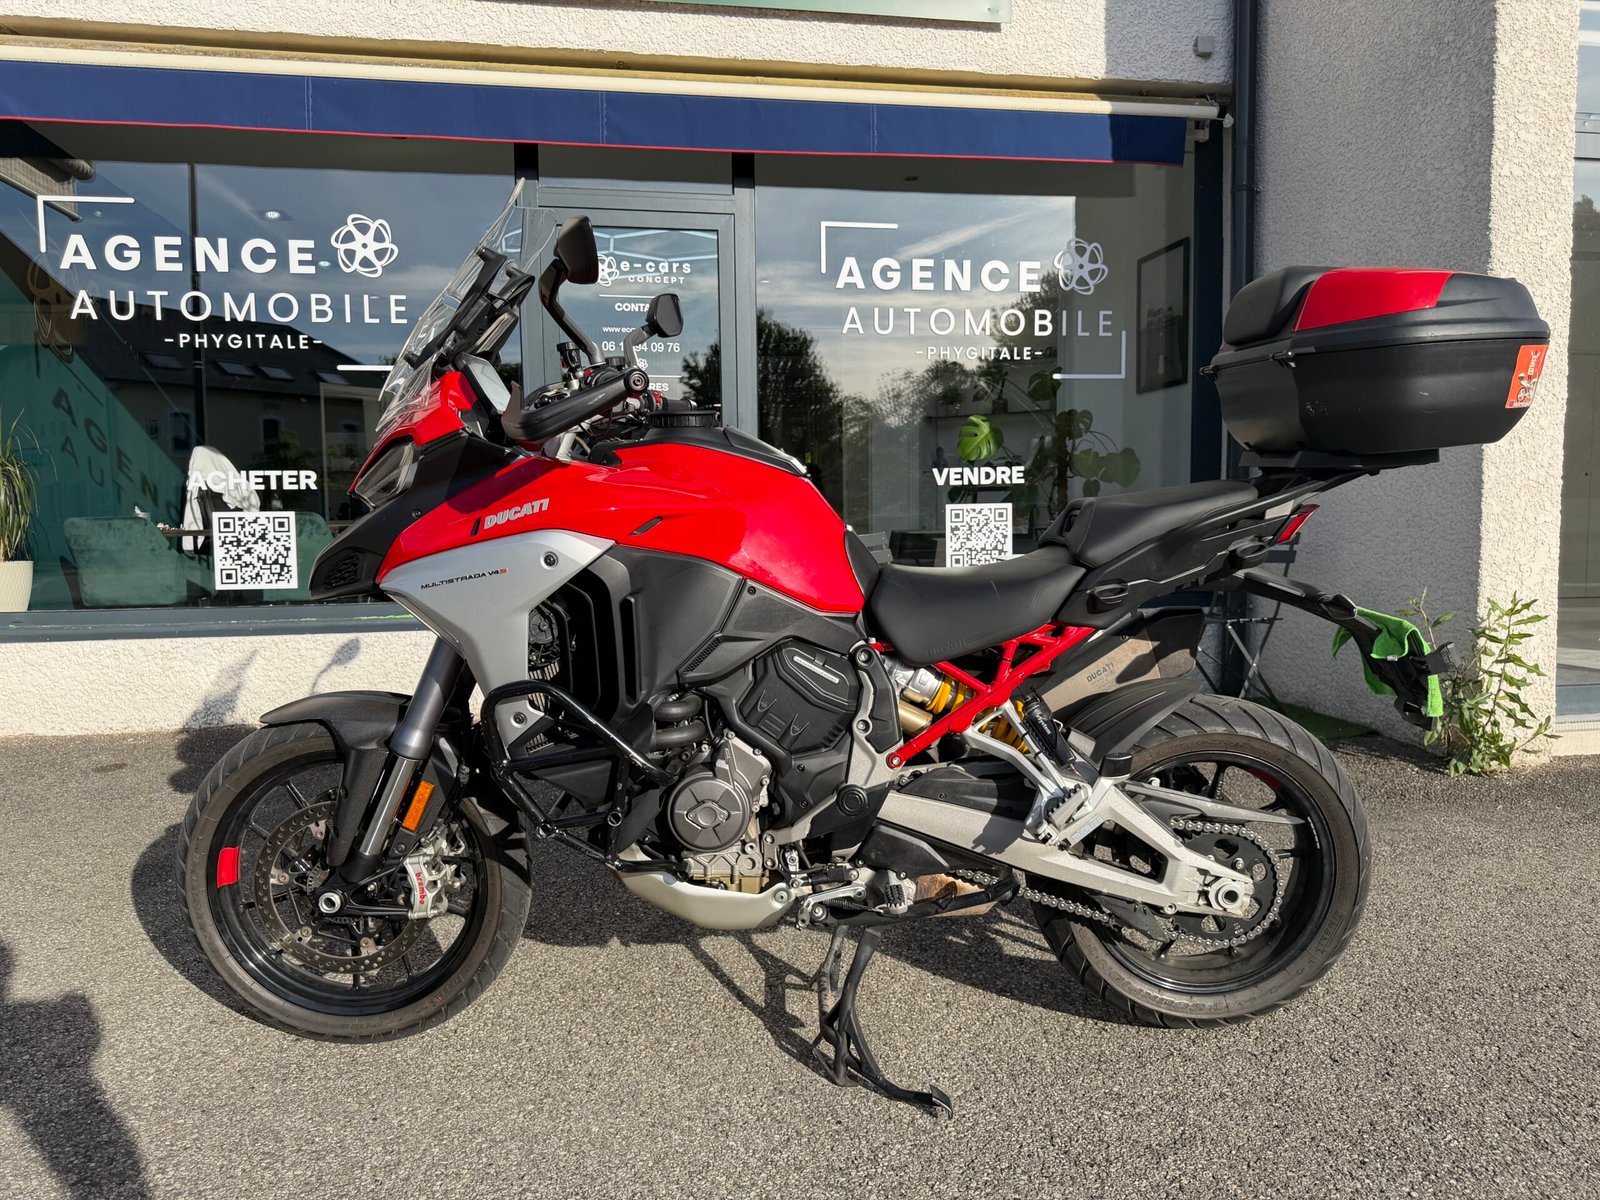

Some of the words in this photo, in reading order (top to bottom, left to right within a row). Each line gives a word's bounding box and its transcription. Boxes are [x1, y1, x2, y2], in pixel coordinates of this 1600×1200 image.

[60, 234, 316, 275] AGENCE
[620, 261, 691, 274] e-cars
[835, 256, 1041, 293] AGENCE
[628, 275, 685, 284] CONCEPT
[71, 289, 408, 324] AUTOMOBILE
[615, 303, 651, 312] CONTA
[842, 307, 1113, 337] AUTOMOBILE
[602, 341, 616, 351] 06
[650, 342, 664, 353] 09
[667, 343, 680, 353] 76
[187, 469, 318, 492] ACHETER
[932, 465, 1026, 486] VENDRE
[483, 498, 550, 529] DUCATI
[420, 572, 486, 590] MULTISTRADA
[1086, 661, 1115, 682] DUCATI
[416, 871, 426, 905] brembo
